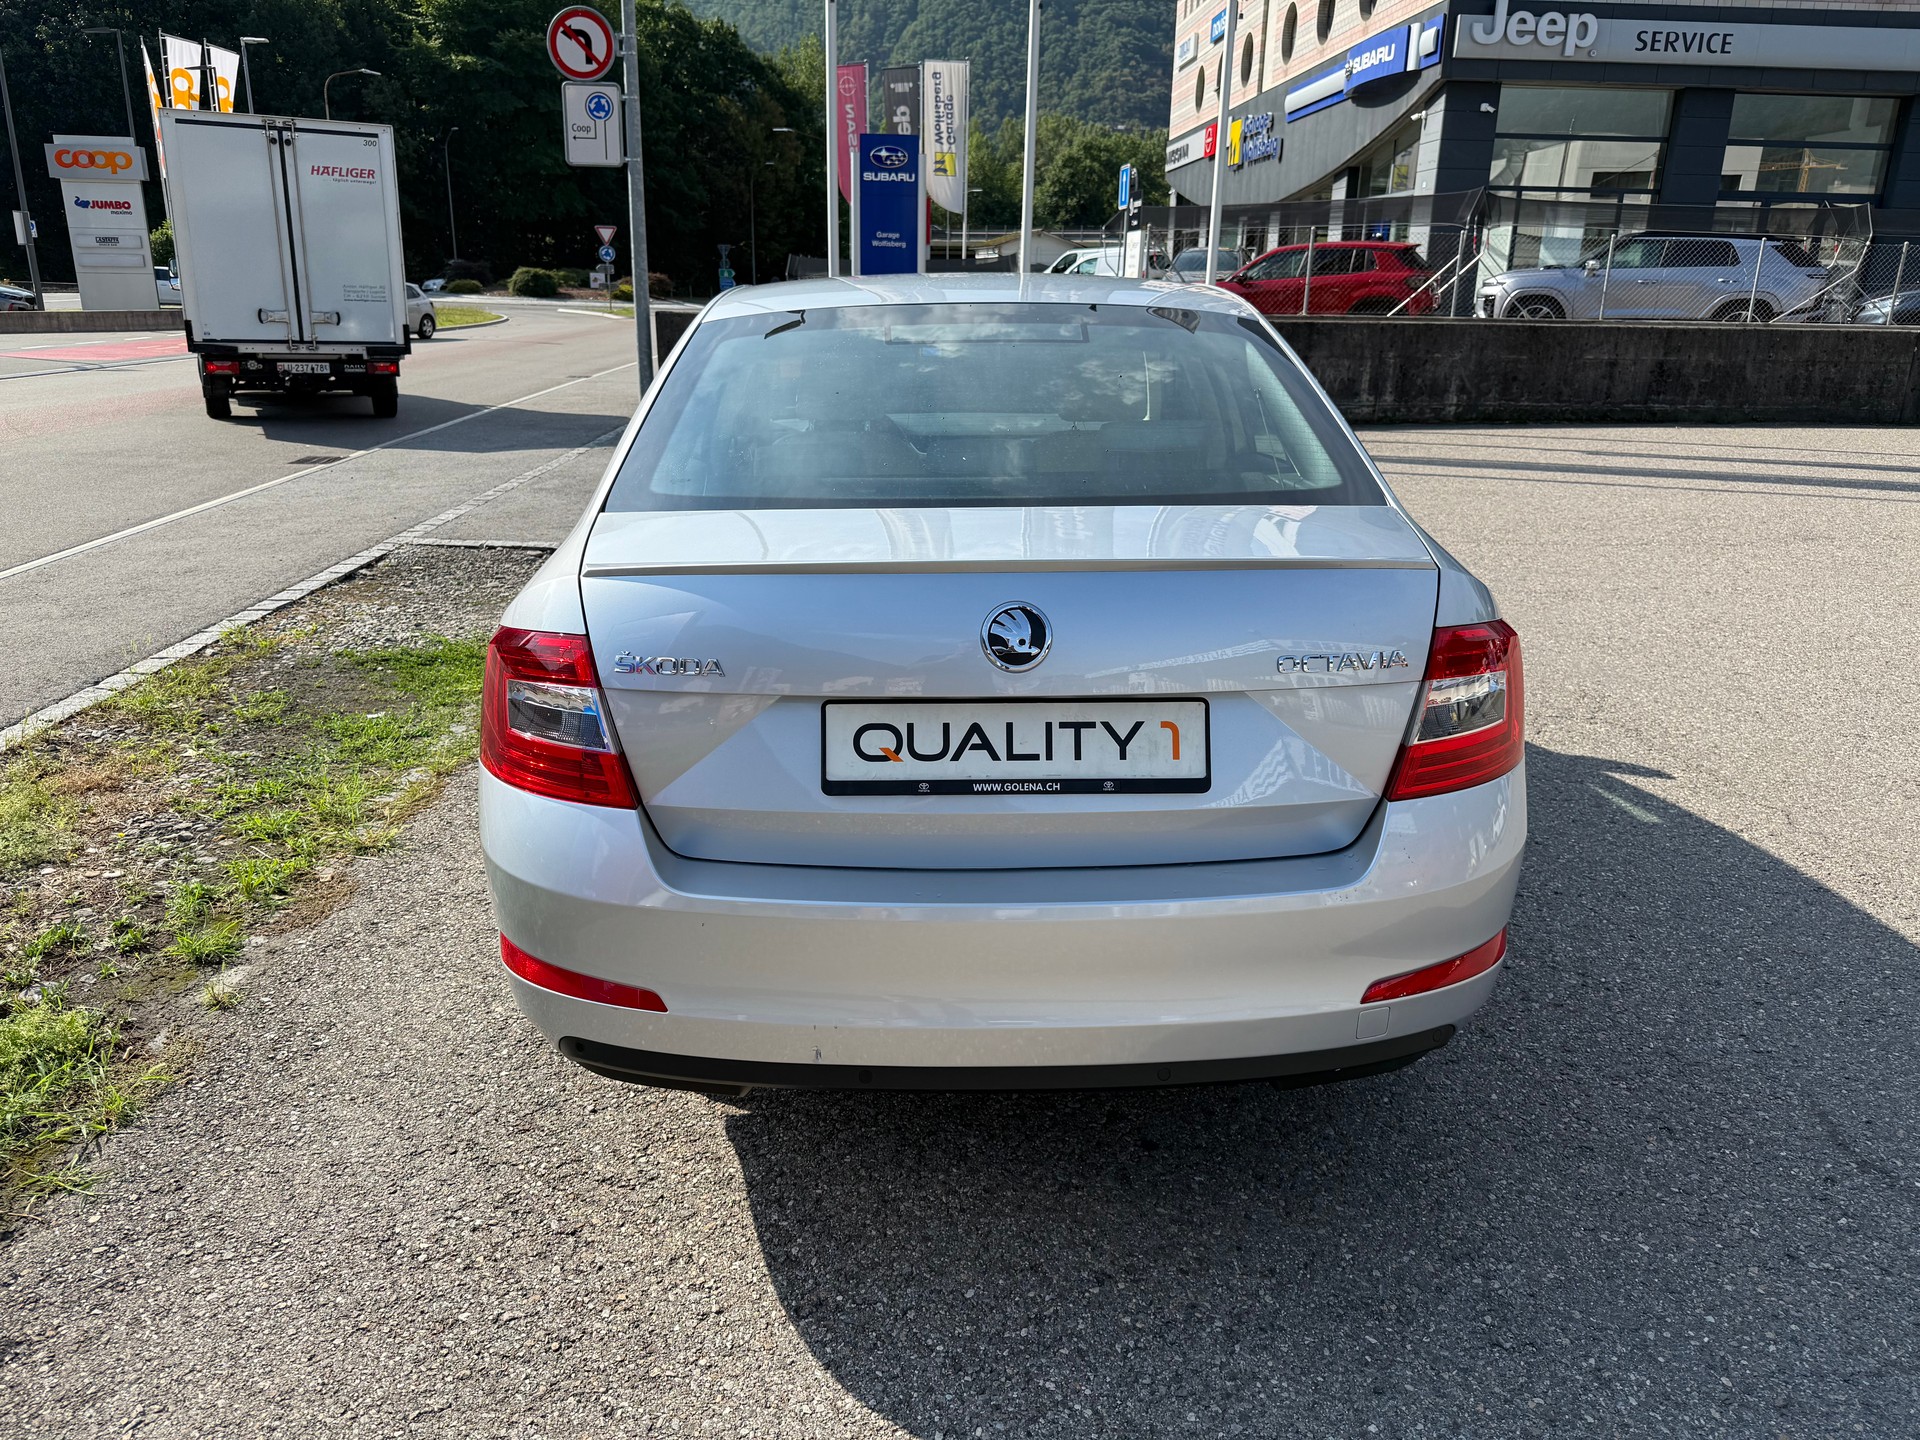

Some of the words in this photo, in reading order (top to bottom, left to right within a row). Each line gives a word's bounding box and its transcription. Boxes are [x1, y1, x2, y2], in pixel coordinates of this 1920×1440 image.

[1471, 0, 1599, 58] Jeep
[1634, 30, 1735, 55] SERVICE
[1352, 43, 1396, 75] SUBARU
[571, 123, 592, 134] Coop
[363, 139, 377, 147] 300
[54, 149, 133, 175] coop
[862, 172, 916, 182] SUBARU
[90, 200, 132, 210] JUMBO
[876, 231, 900, 239] Garage
[871, 239, 907, 249] Wolfisberg
[614, 650, 726, 677] ŠKODA
[1276, 649, 1409, 674] OCTAVIA
[973, 782, 1061, 792] WWW.GOLENA.CH
